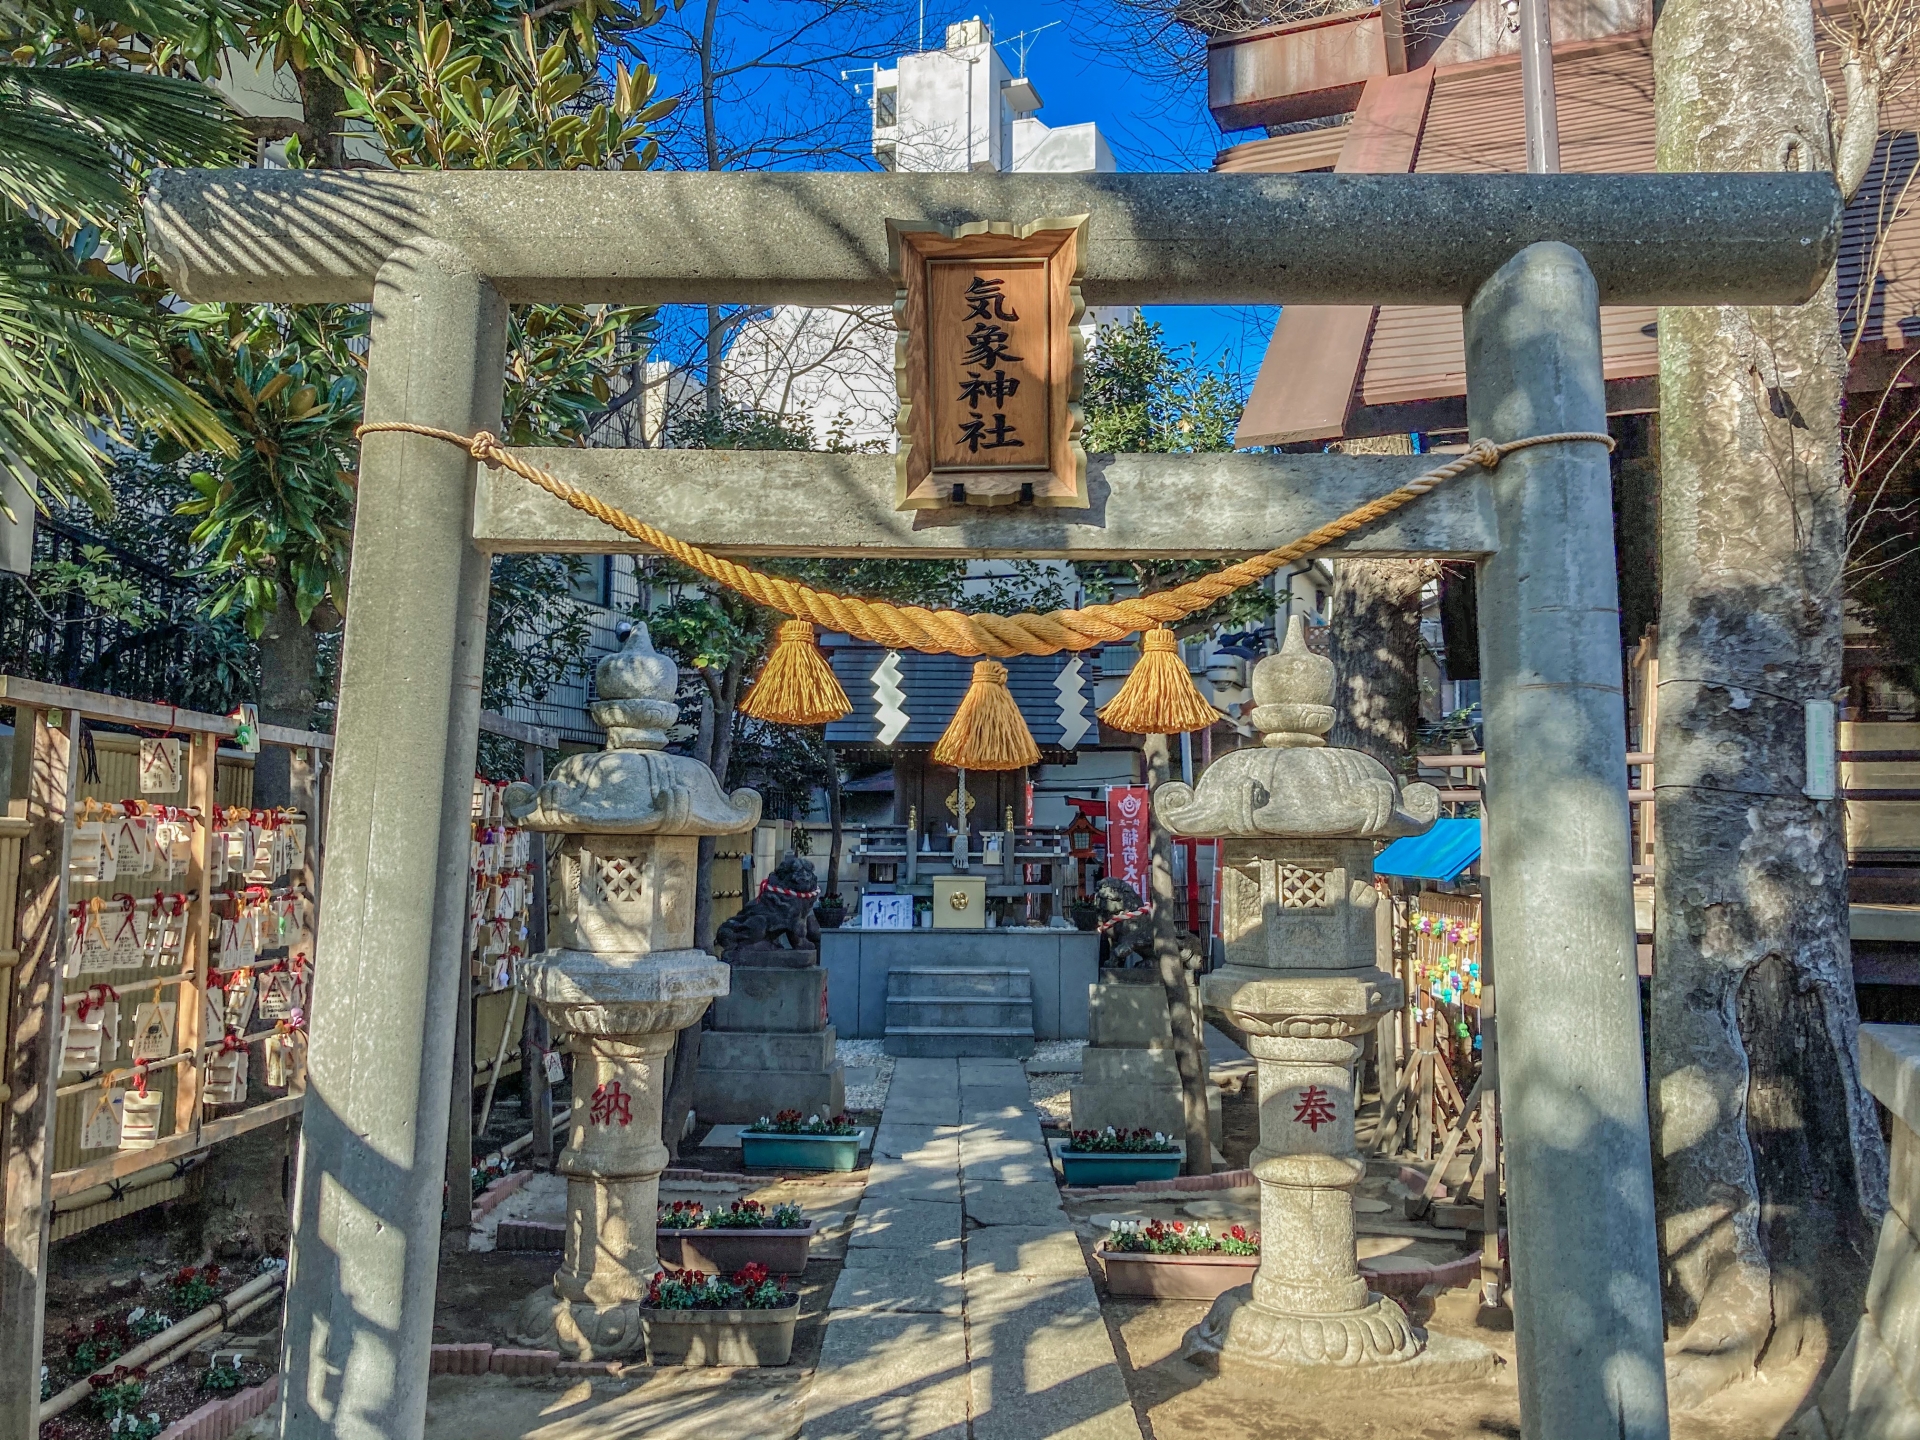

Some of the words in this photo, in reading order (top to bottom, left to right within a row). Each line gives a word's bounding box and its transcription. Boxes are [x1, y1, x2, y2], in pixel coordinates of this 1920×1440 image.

[955, 276, 1024, 453] 気象神社
[589, 1081, 633, 1127] 納
[1293, 1084, 1337, 1133] 奉
